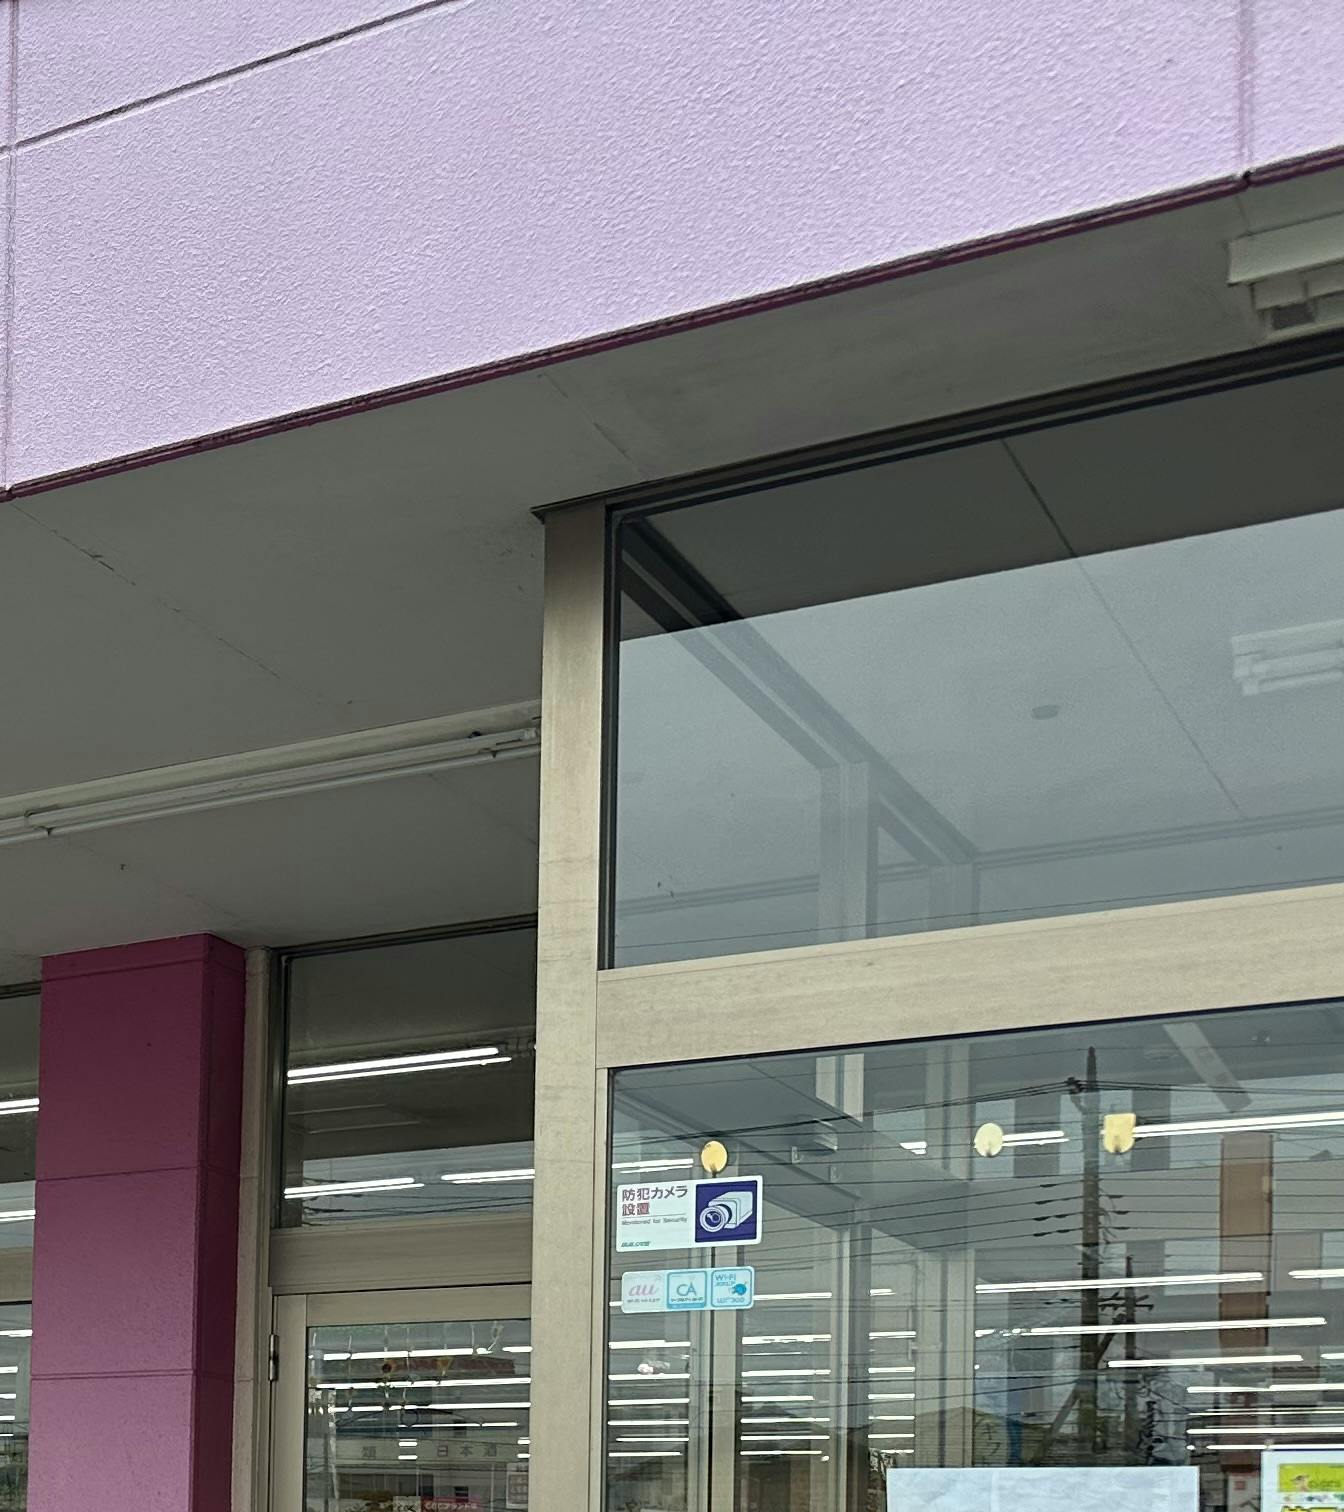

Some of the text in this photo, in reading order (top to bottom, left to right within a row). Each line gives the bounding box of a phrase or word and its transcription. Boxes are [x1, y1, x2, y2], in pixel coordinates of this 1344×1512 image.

[621, 1185, 689, 1202] 防犯カメラ
[621, 1202, 650, 1216] 設置
[629, 1283, 659, 1297] au
